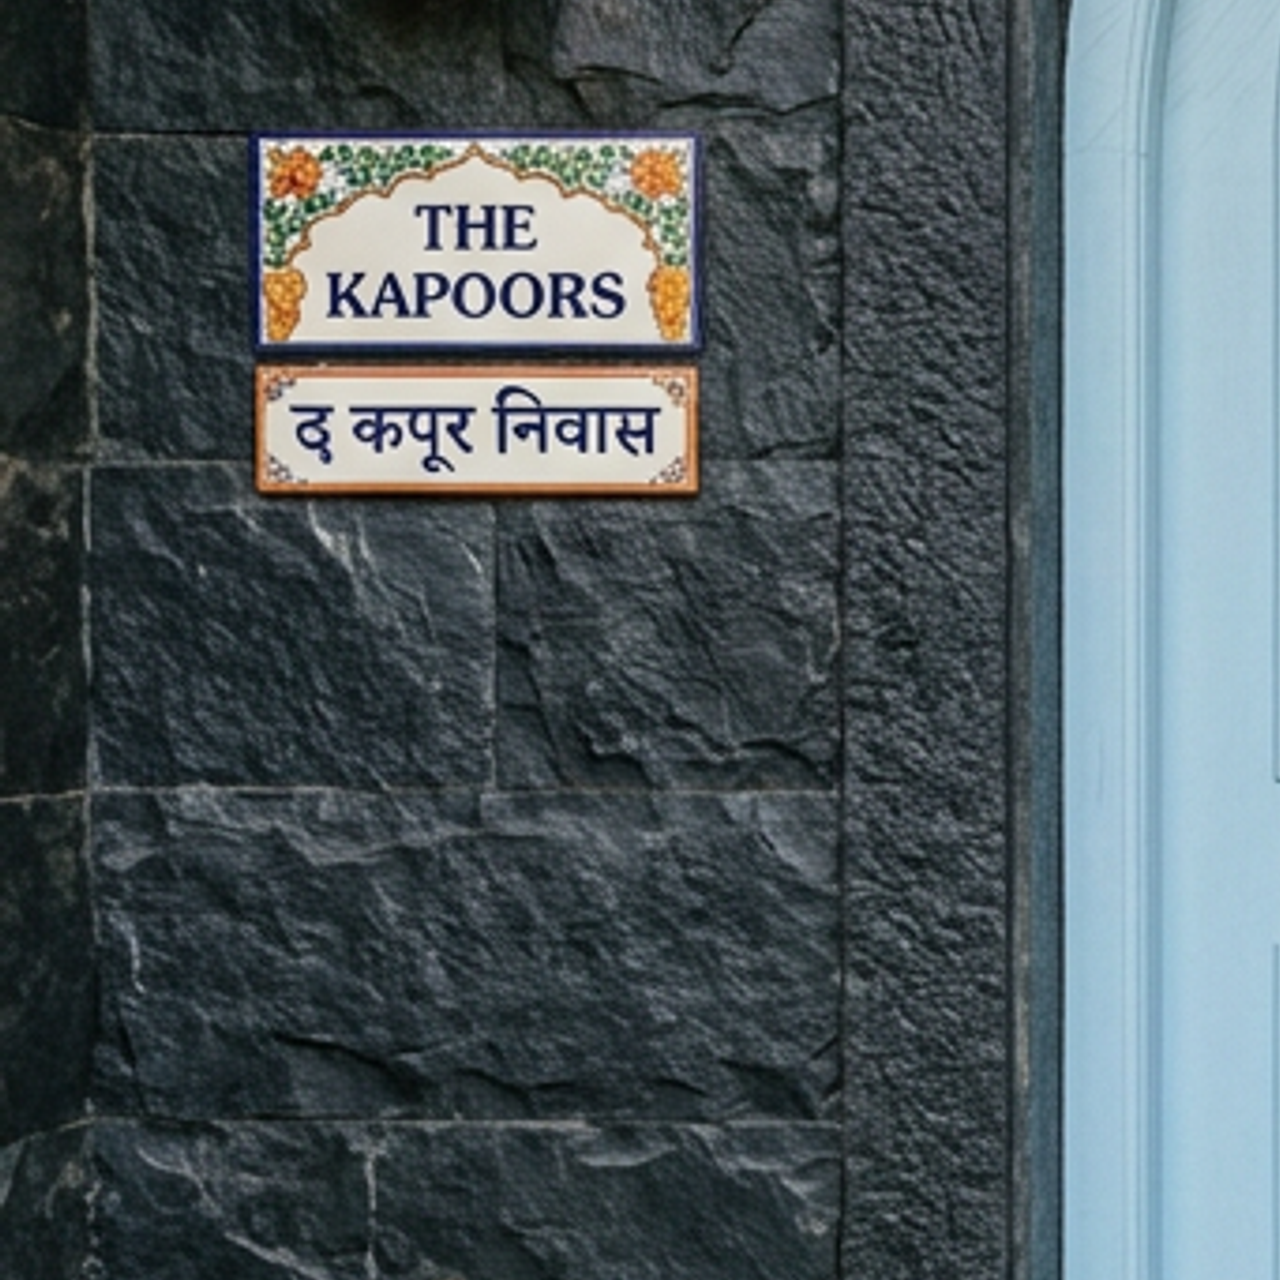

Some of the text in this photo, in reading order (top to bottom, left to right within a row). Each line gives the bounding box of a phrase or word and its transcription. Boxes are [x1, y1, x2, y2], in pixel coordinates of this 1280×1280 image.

[414, 204, 538, 251] THE
[326, 271, 627, 319] KAPOORS
[349, 406, 477, 473] कपूर
[491, 385, 662, 457] निवास
